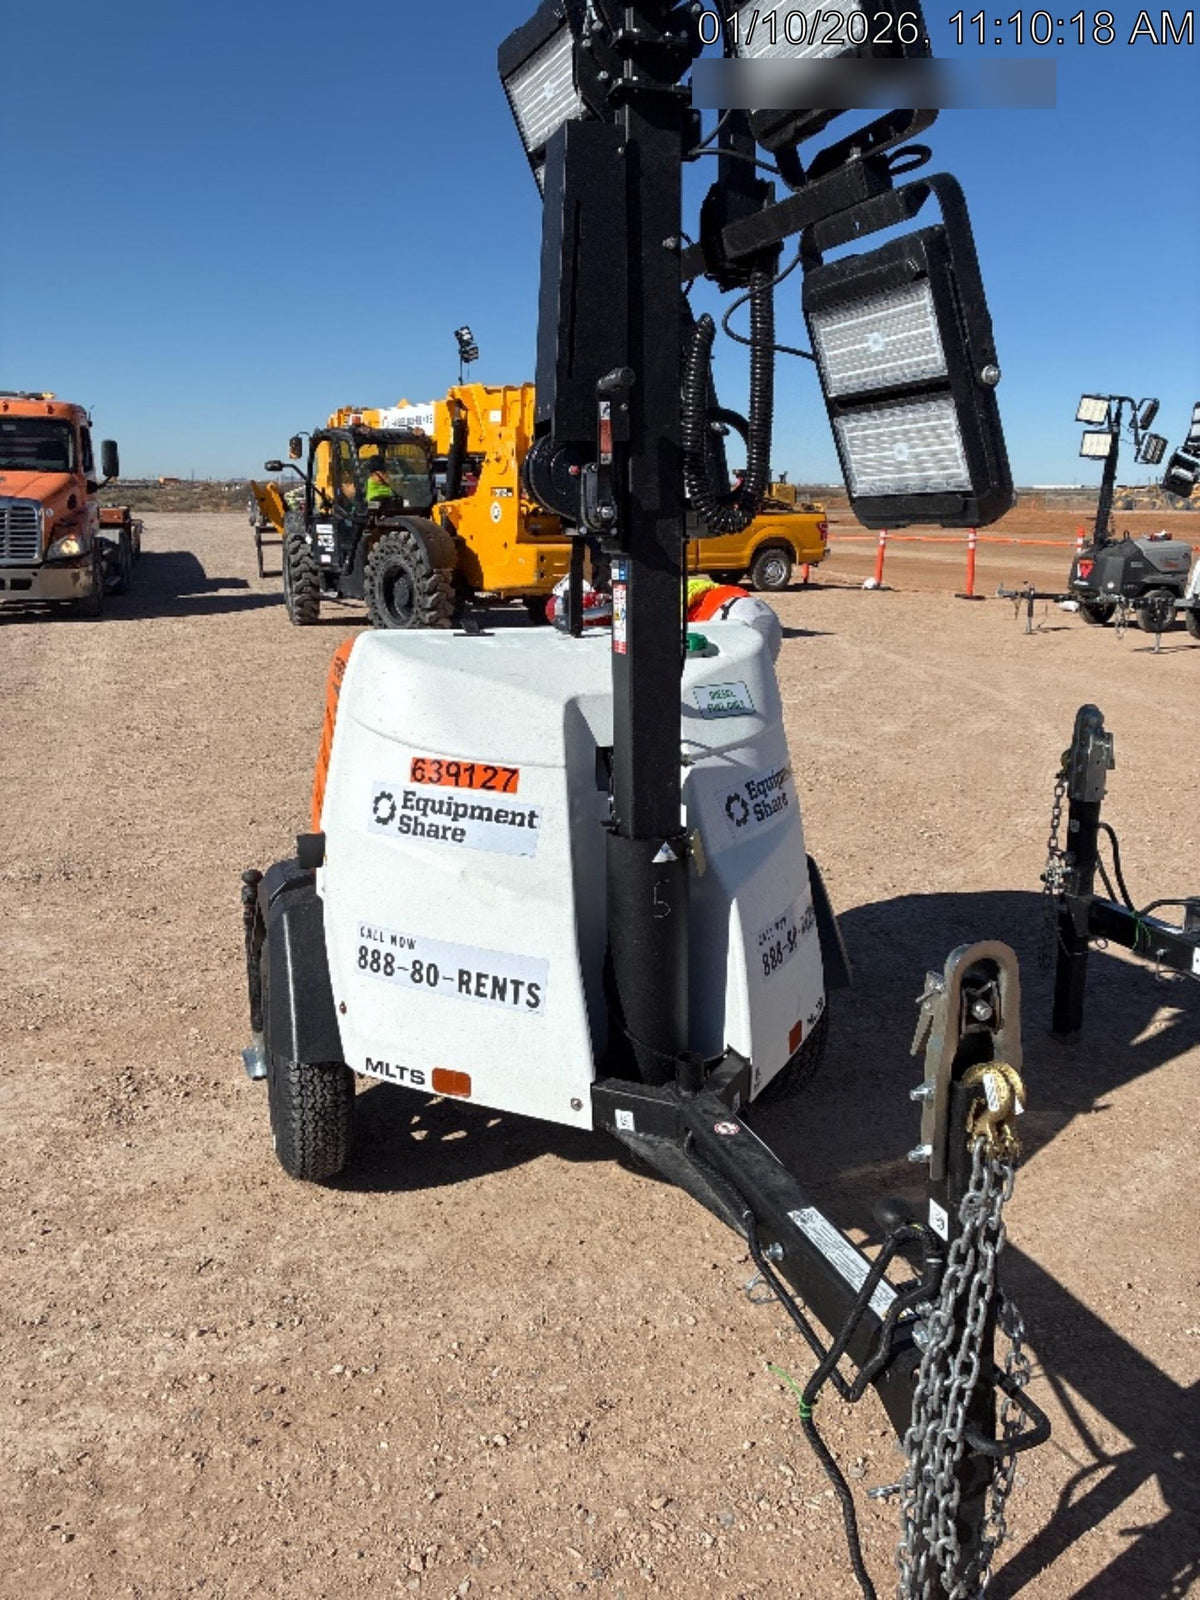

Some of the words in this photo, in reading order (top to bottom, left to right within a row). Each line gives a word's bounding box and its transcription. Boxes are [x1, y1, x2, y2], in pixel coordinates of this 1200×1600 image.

[411, 758, 519, 792] 639127
[401, 789, 540, 829] Equipment
[398, 814, 466, 843] Share
[360, 925, 385, 943] CALL
[390, 934, 416, 950] NOW
[358, 945, 541, 1009] 888-80-RENTS
[365, 1057, 426, 1086] MLTS
